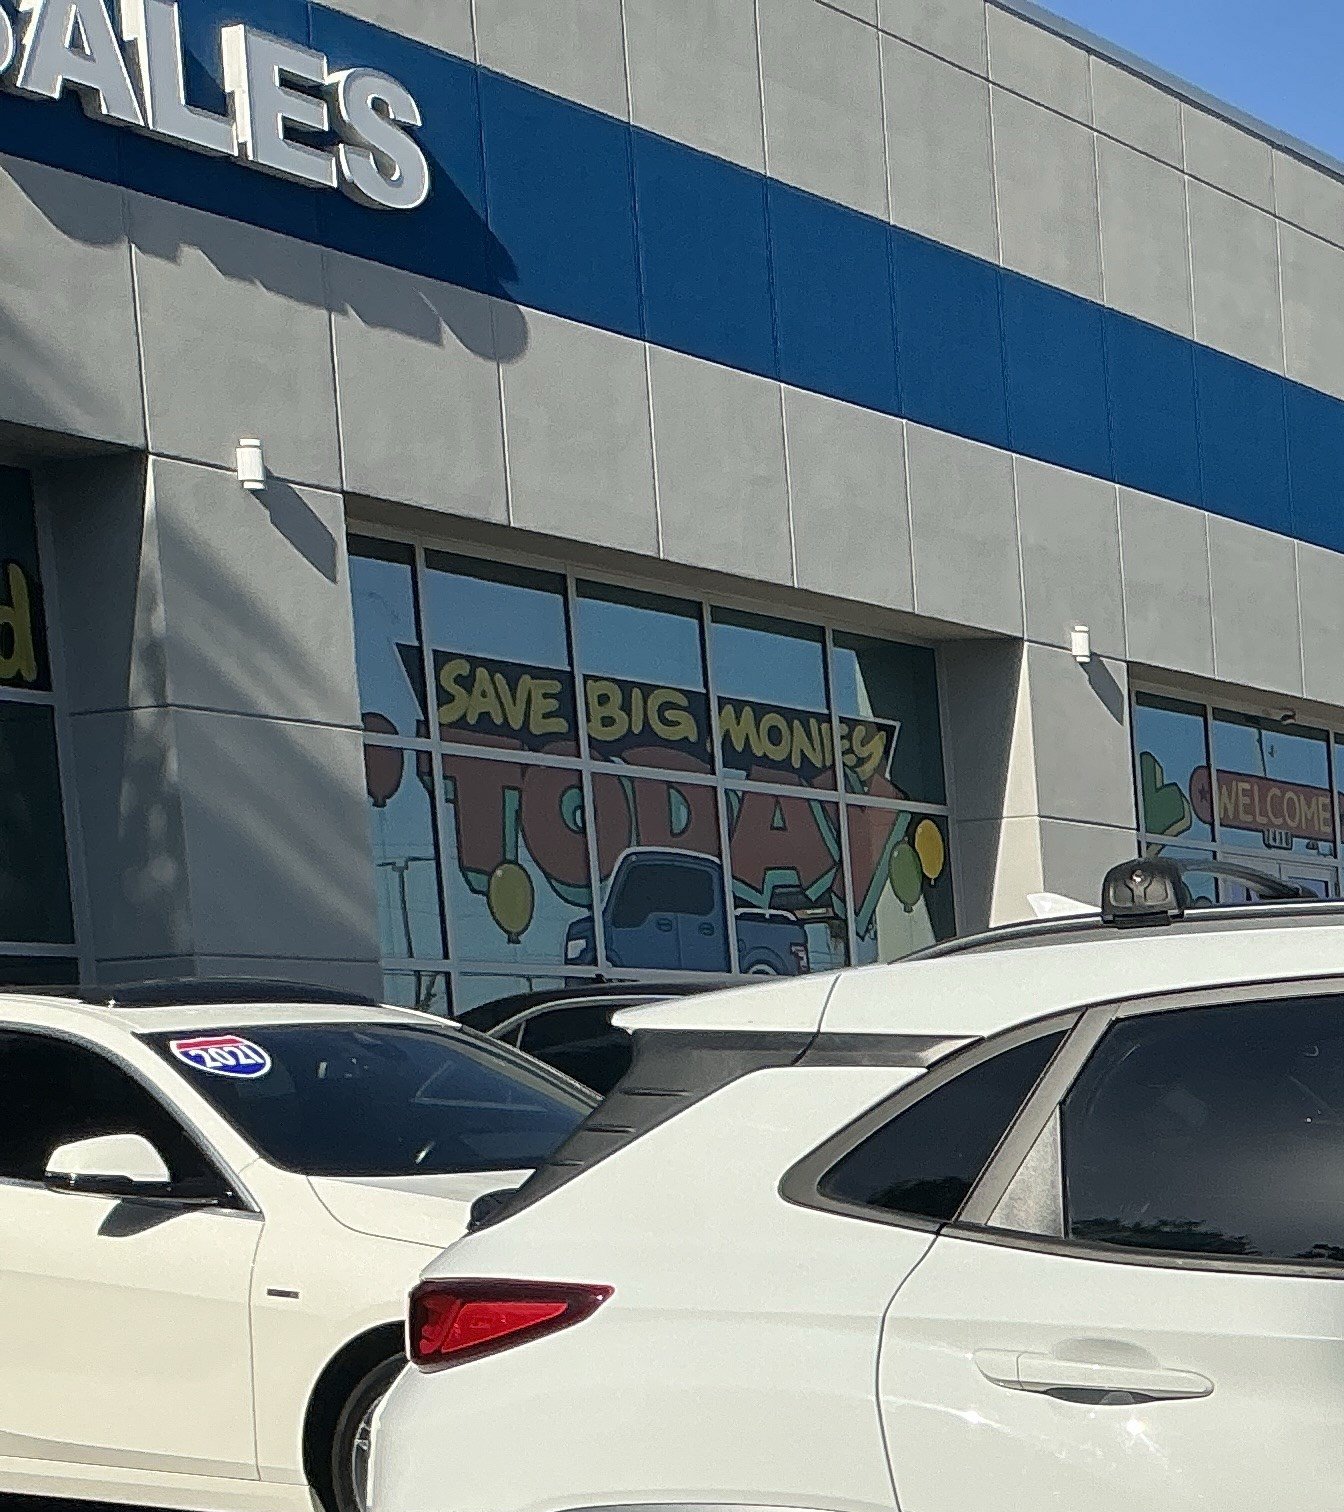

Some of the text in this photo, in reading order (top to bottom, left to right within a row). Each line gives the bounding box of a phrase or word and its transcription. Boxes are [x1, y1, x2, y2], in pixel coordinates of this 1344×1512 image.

[0, 0, 430, 210] ALES
[439, 658, 887, 780] SAVE BIG MONEY
[417, 718, 908, 940] TODAY
[1218, 779, 1332, 834] WELCOME
[188, 1044, 265, 1068] 2021
